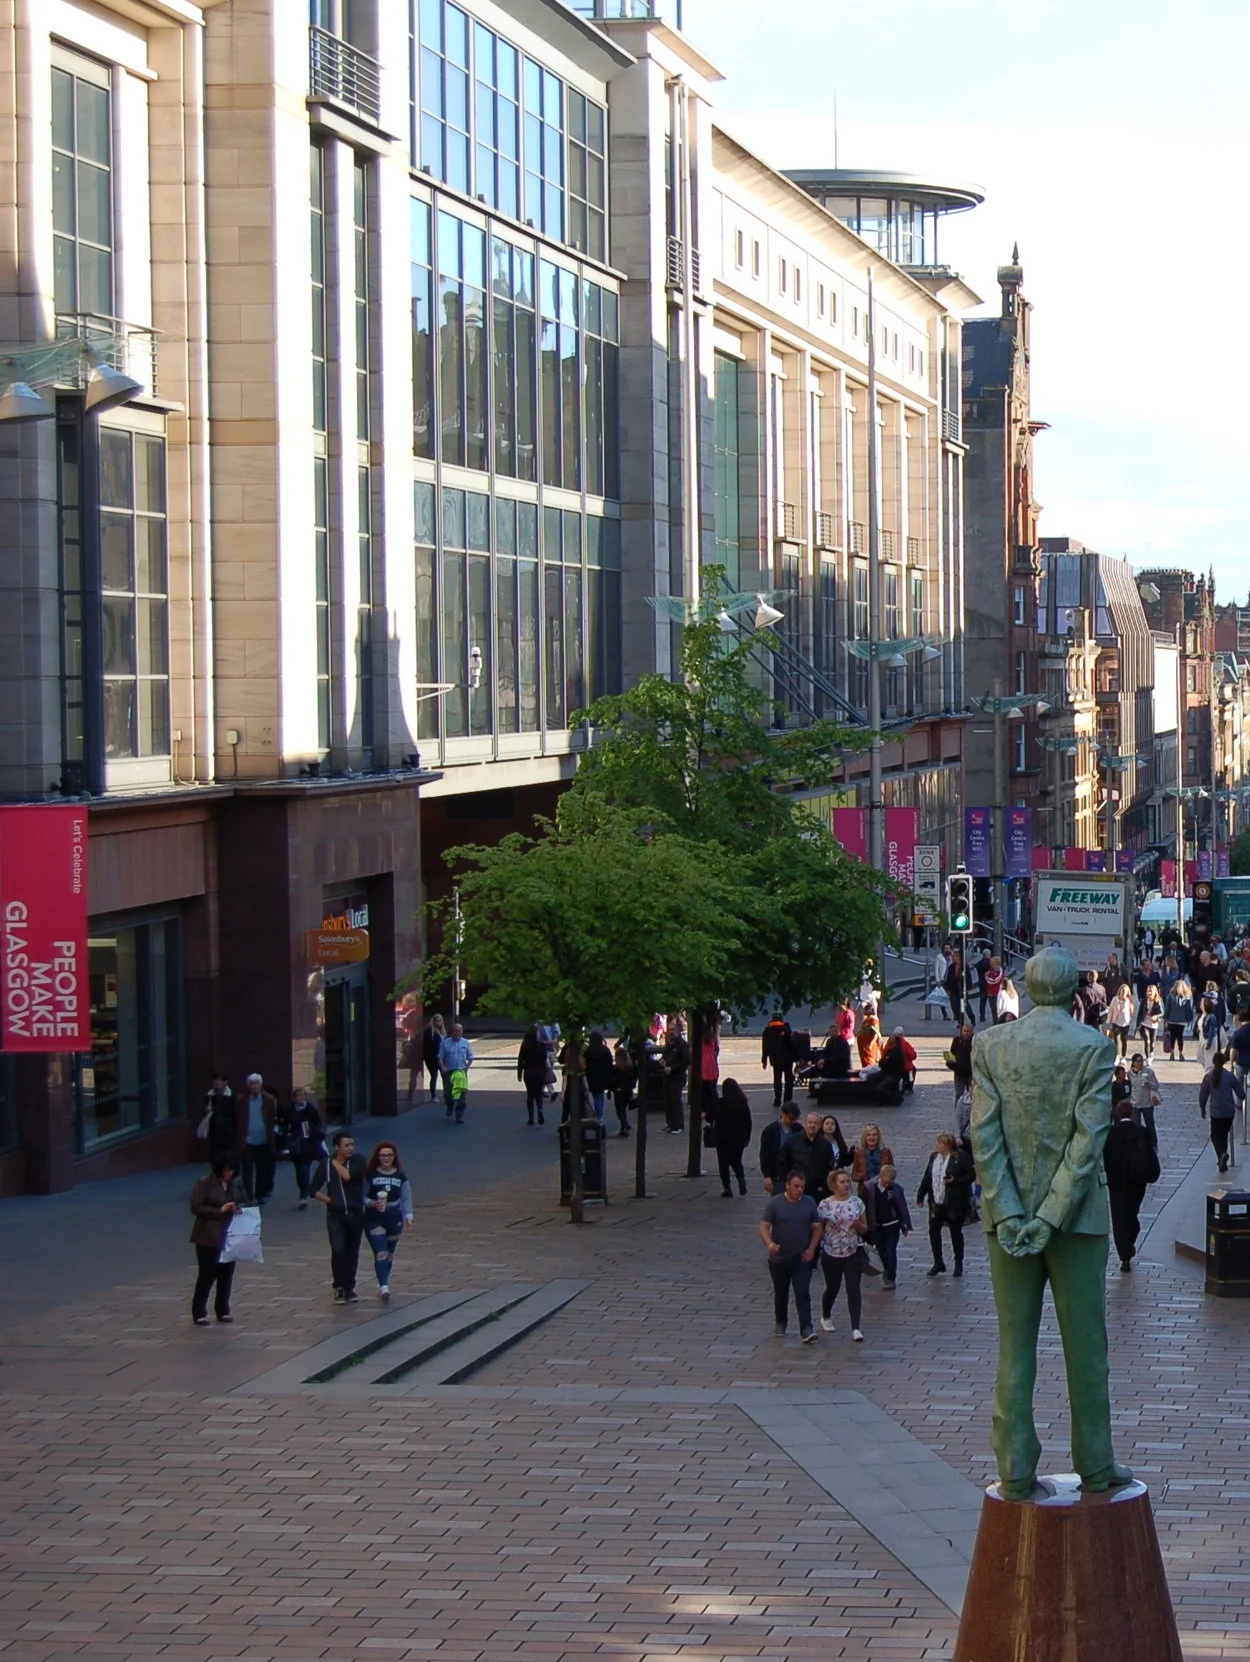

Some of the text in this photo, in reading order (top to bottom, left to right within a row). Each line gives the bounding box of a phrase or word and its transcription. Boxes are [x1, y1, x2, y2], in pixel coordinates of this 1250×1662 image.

[72, 819, 83, 894] Let's Celebrate
[889, 841, 898, 882] GLASGO
[1049, 887, 1120, 905] FREEWAY
[1092, 907, 1119, 915] RENTAL
[351, 904, 369, 929] Local
[318, 935, 361, 944] Sainsbury's
[318, 948, 339, 957] Local
[5, 900, 31, 1037] GLASGOW
[31, 962, 54, 1037] MAKE
[53, 941, 79, 1037] PEOPLE
